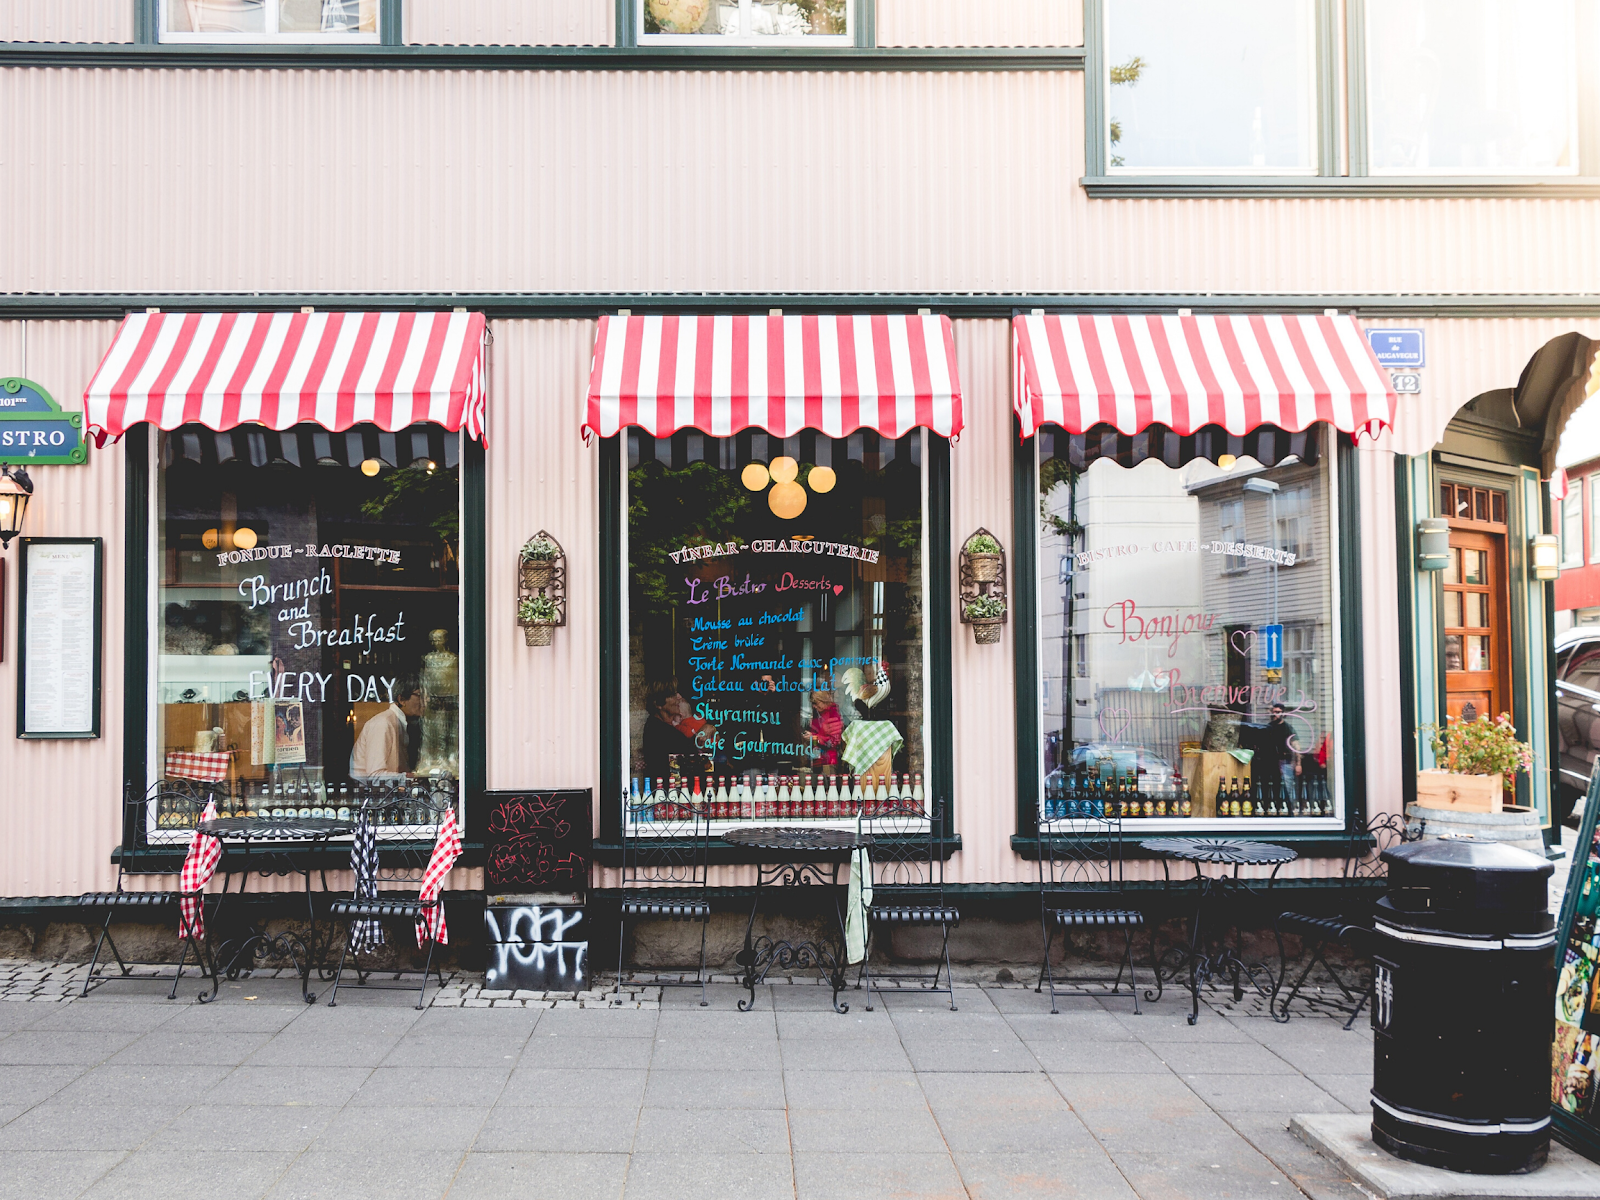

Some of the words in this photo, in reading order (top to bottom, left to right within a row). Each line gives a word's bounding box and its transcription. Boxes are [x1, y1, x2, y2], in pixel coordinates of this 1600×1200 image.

[1395, 376, 1416, 390] 12
[216, 544, 292, 567] FONDUE
[305, 543, 401, 564] RACLETTE
[751, 539, 880, 564] CHARCUTERIE
[1076, 543, 1139, 567] BISTRO
[1153, 537, 1198, 553] CAFÉ
[1211, 540, 1297, 567] DESSERTS
[238, 567, 332, 610] Brunch
[685, 576, 709, 605] Le
[713, 573, 767, 601] Bistro
[774, 571, 831, 592] Desserts
[278, 598, 310, 621] and
[690, 617, 732, 632] Mousse
[738, 618, 753, 627] au
[758, 607, 805, 625] chocolat
[288, 611, 406, 655] Breakfast
[1103, 598, 1222, 658] Bonjour
[690, 637, 728, 651] Crème
[688, 656, 725, 672] Torte
[730, 653, 793, 670] Normande
[798, 658, 823, 668] aux
[249, 670, 332, 702] EVERY
[346, 674, 396, 703] DAY
[691, 675, 744, 700] Gateau
[751, 680, 769, 692] au
[775, 672, 837, 693] chocolat
[1154, 667, 1287, 707] Bienvenue
[693, 702, 781, 728] Skyramisu
[694, 731, 726, 760] Café
